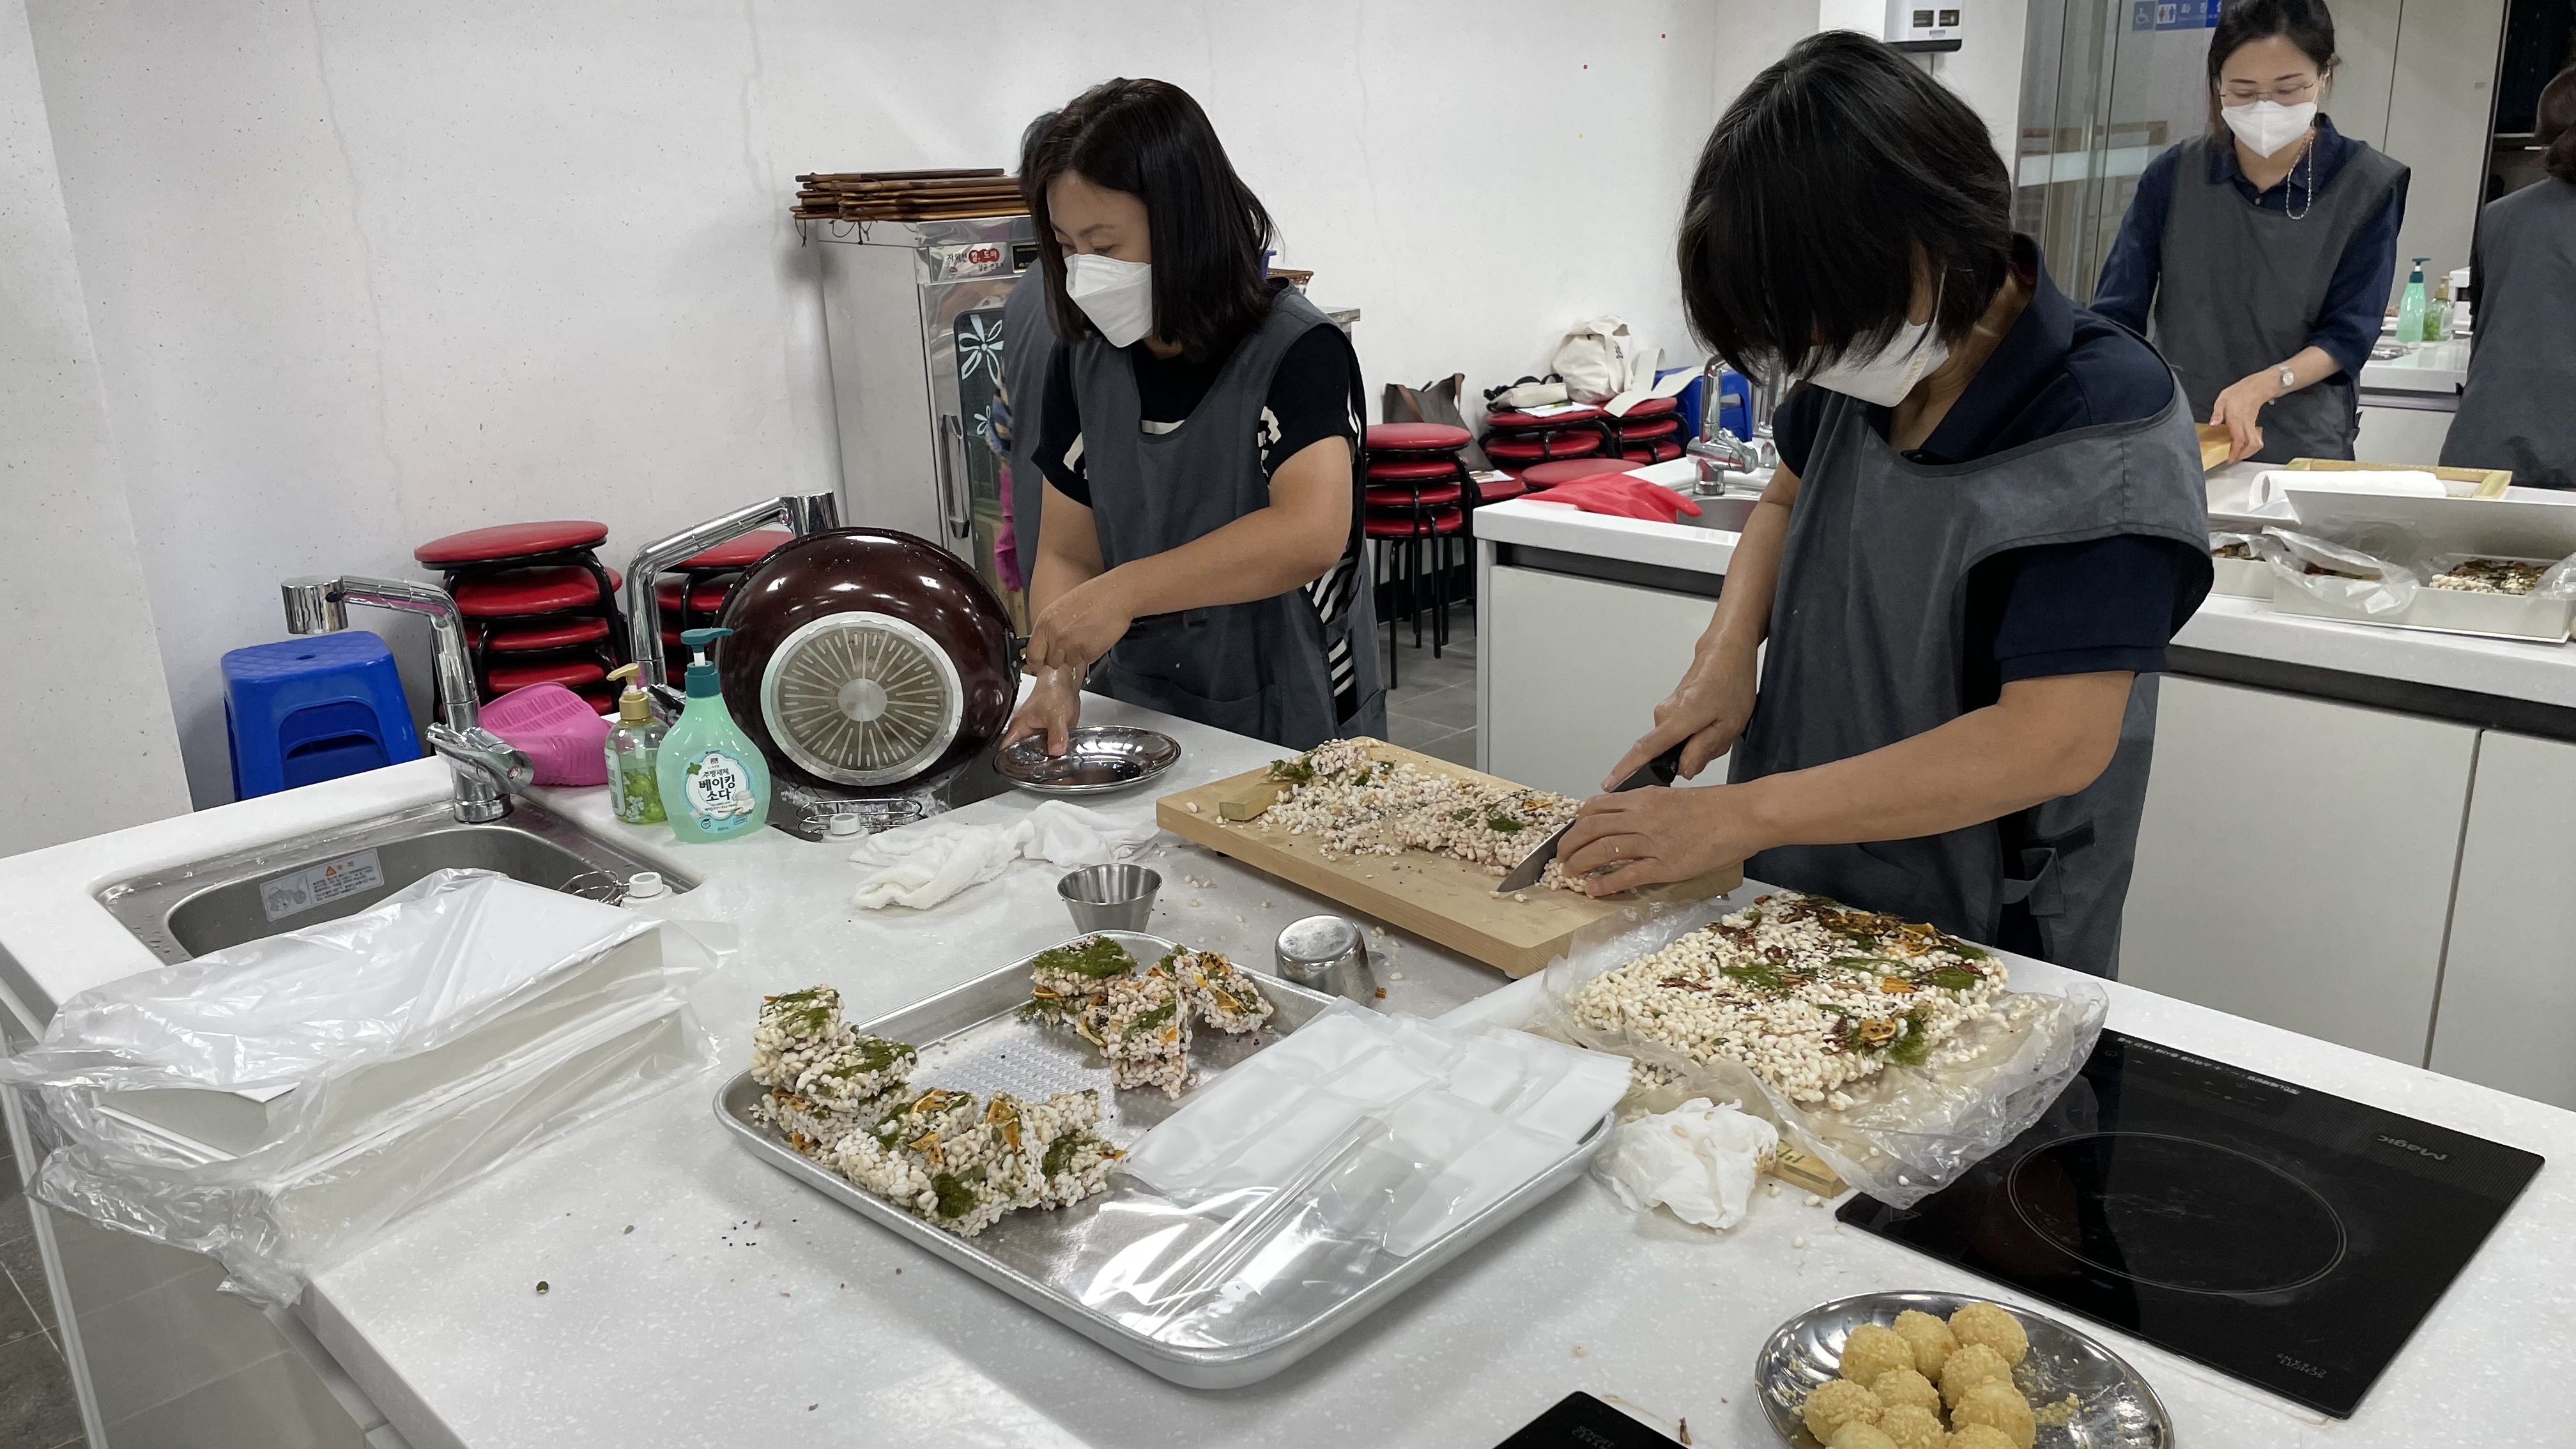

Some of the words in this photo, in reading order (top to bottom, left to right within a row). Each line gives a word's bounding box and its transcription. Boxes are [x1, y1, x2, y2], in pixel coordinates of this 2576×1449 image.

[698, 774, 735, 791] 베이킹
[705, 788, 732, 802] 소다
[2377, 1134, 2448, 1161] Magic
